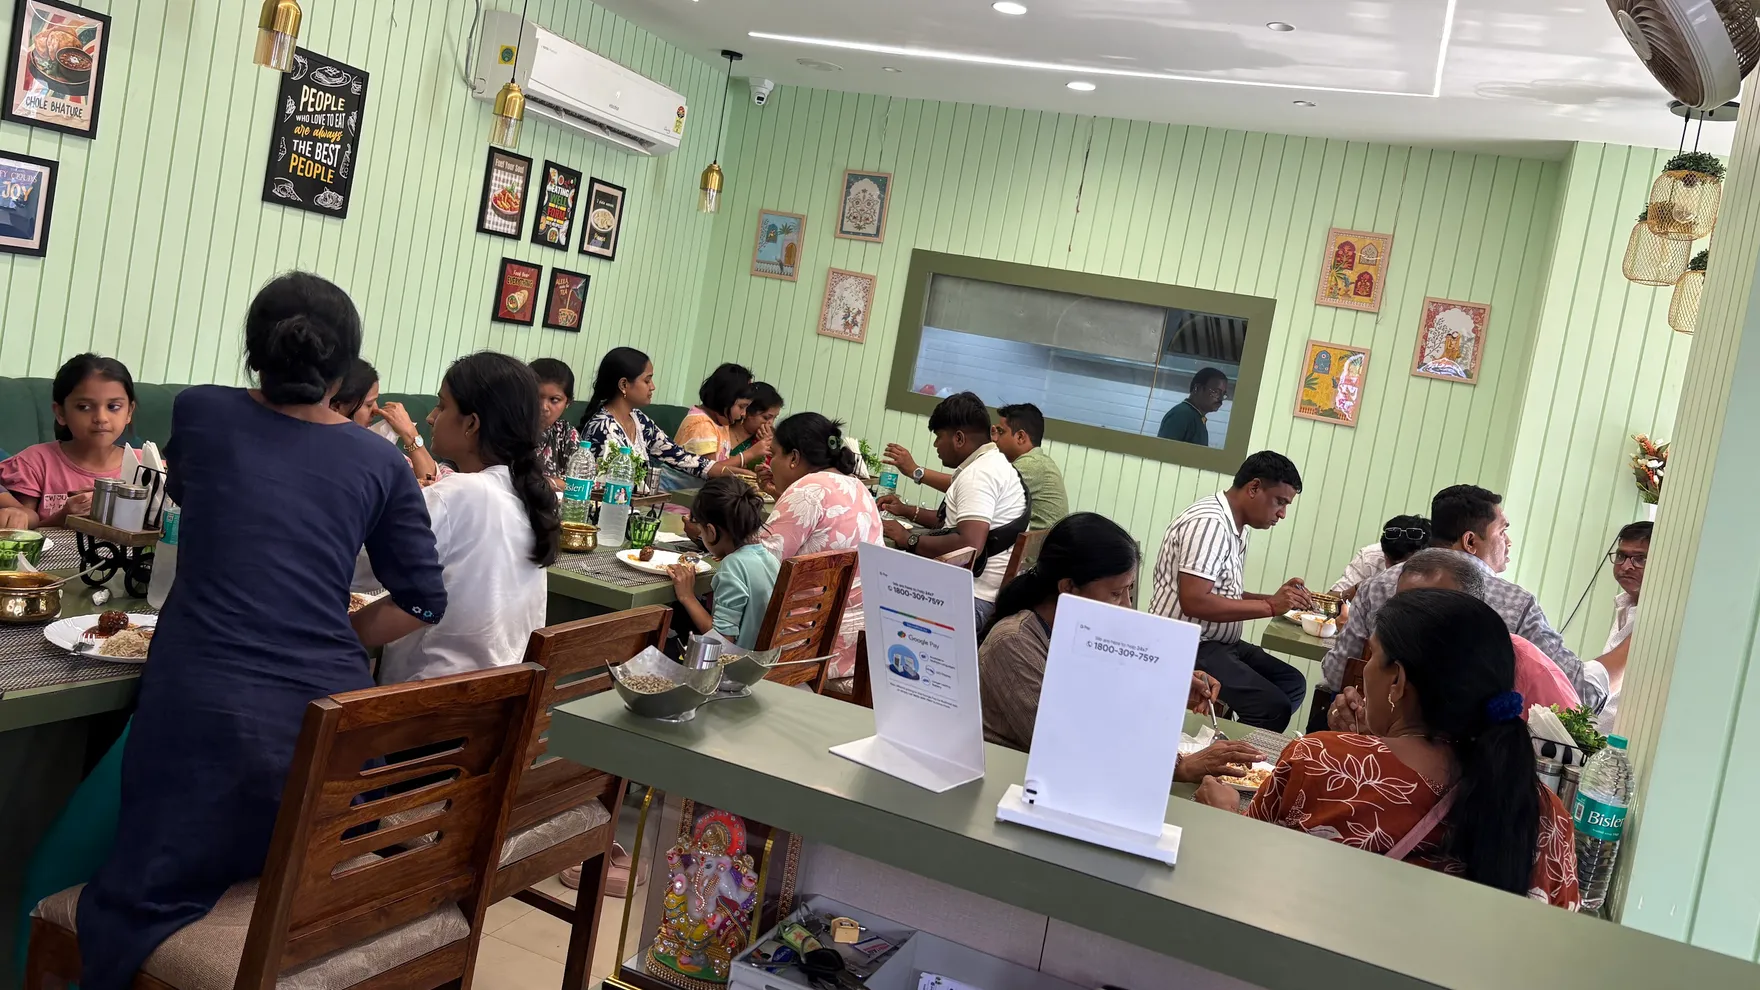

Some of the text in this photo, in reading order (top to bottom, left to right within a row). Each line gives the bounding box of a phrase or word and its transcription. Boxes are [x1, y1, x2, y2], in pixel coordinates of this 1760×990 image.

[26, 96, 83, 118] CHOLE BHATURE
[300, 85, 345, 112] PEOPLE
[296, 113, 346, 128] WHO LOVE TO EAT
[294, 124, 343, 142] are always
[293, 139, 341, 167] THE BEST
[289, 153, 335, 184] PEOPLE
[2, 180, 33, 201] JOY
[551, 193, 567, 206] WELL
[552, 186, 569, 197] EATING
[893, 586, 944, 606] 1800-309-7597
[908, 634, 940, 650] Google Pay
[1094, 642, 1160, 664] 1800-309-7597
